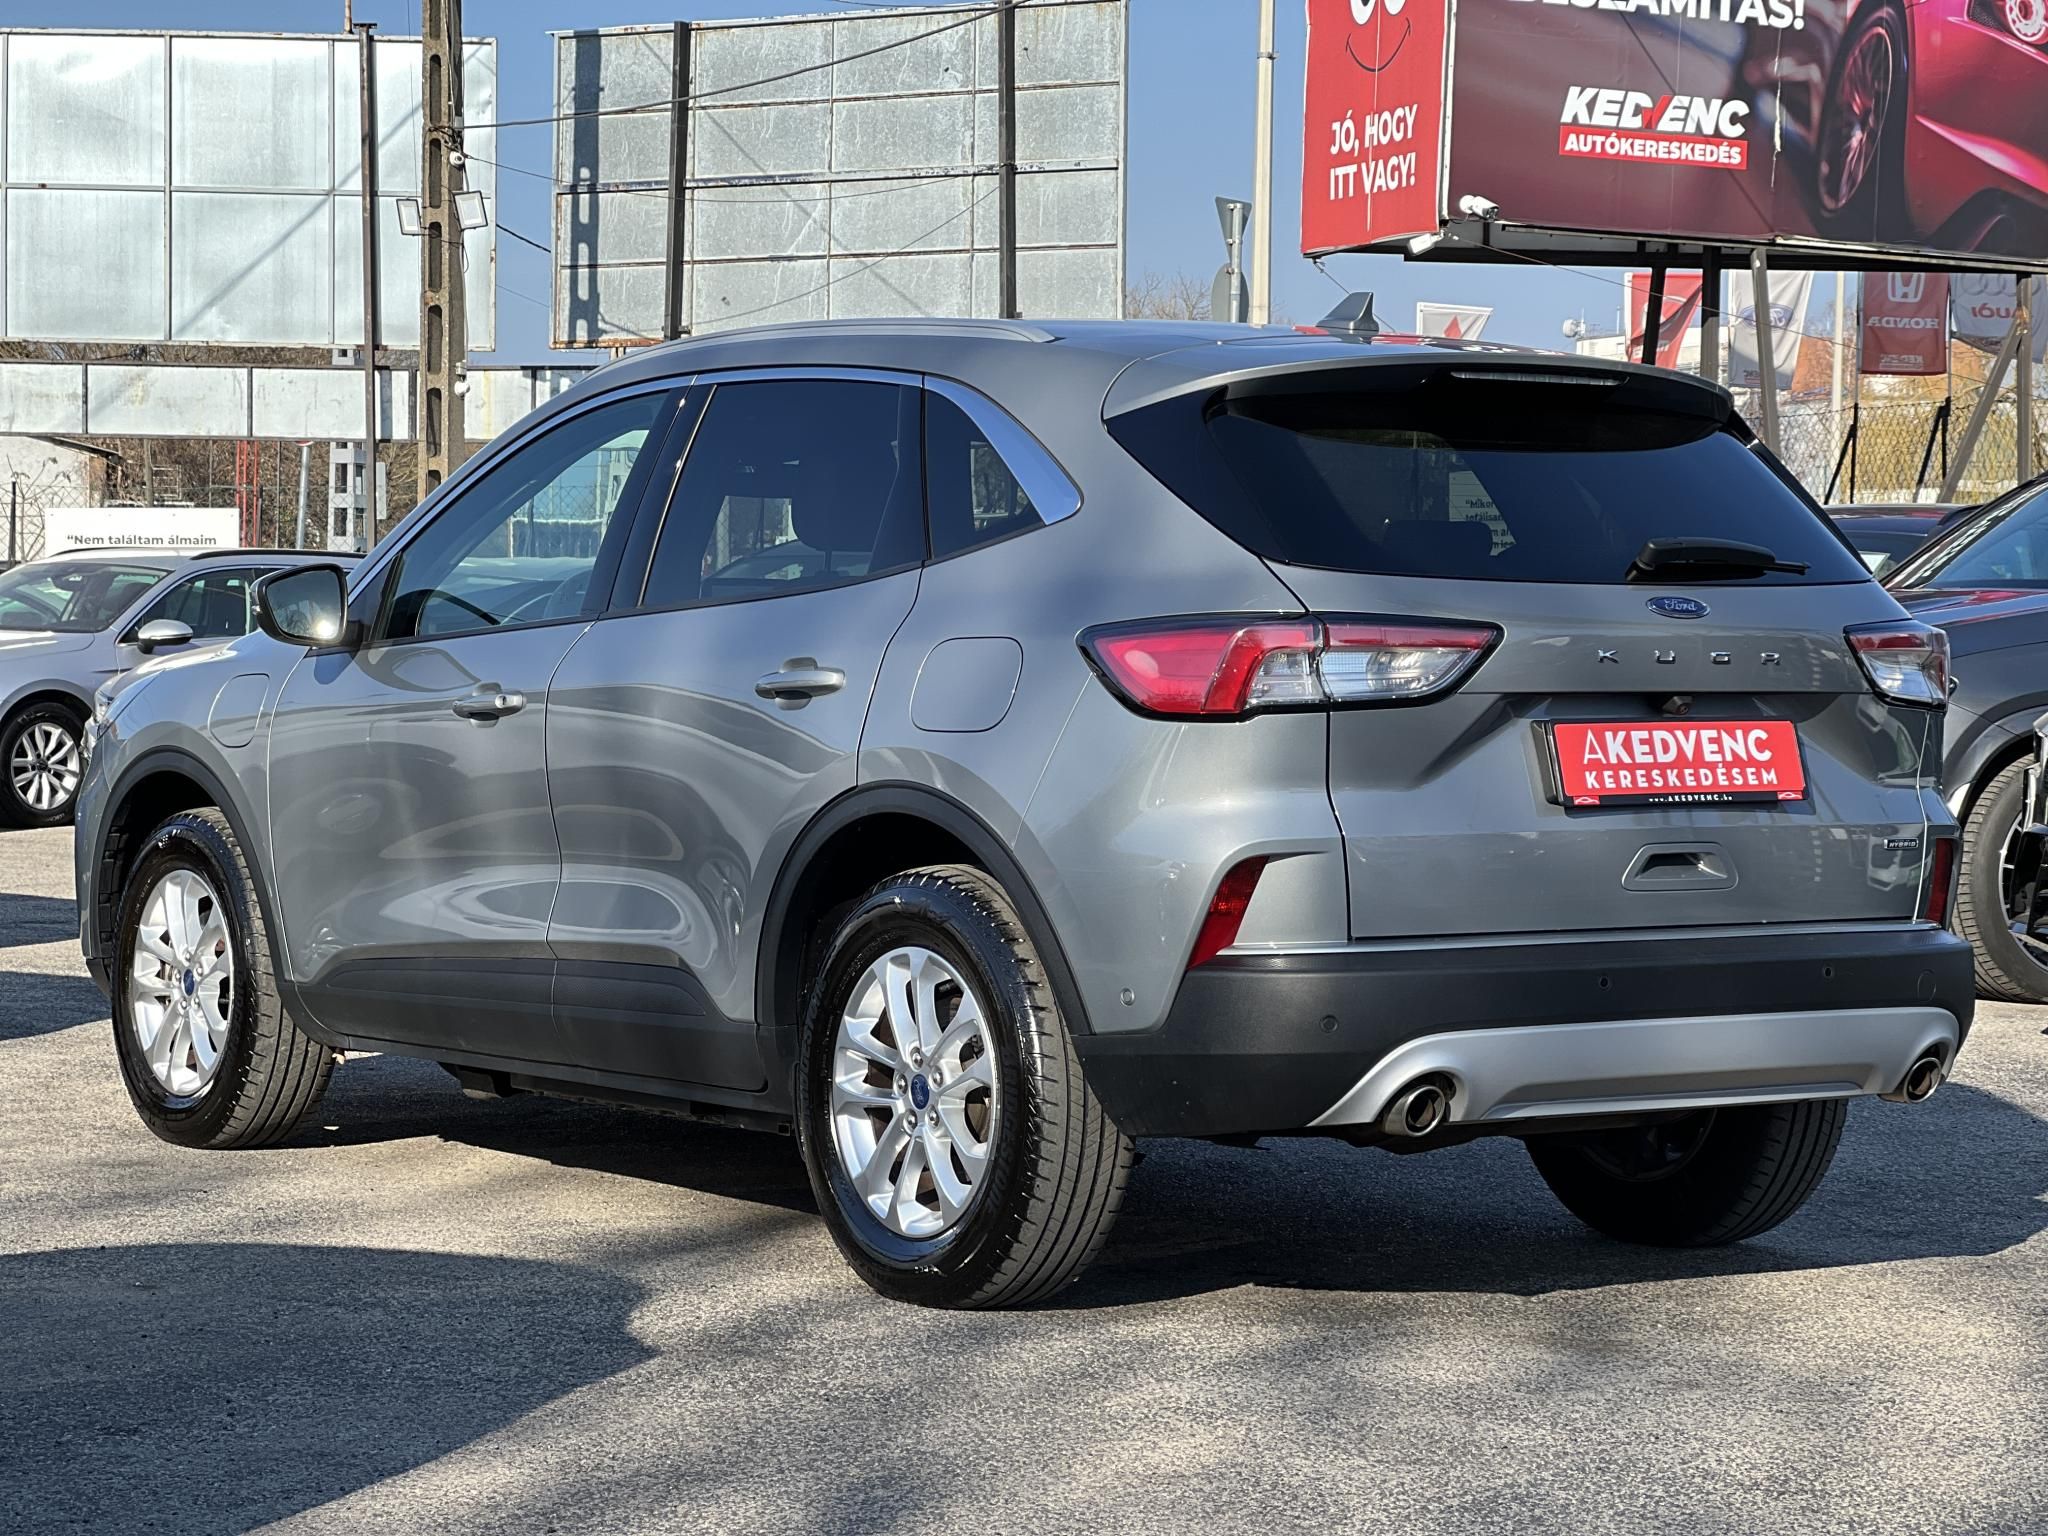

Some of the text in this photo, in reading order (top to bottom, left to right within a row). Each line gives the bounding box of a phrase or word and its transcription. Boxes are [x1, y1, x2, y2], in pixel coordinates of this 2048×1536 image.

[1560, 86, 1750, 138] KEDVENC
[1330, 103, 1418, 157] JÓ, HOGY
[1564, 132, 1742, 165] AUTÓKERESKEDÉS
[1329, 151, 1416, 201] ITT VAGY!
[108, 534, 164, 545] találtam
[168, 534, 217, 545] álmaim
[1664, 598, 1698, 611] Ford
[1598, 649, 1781, 666] KUGA
[1584, 763, 1778, 789] KERESKEDÉSEM
